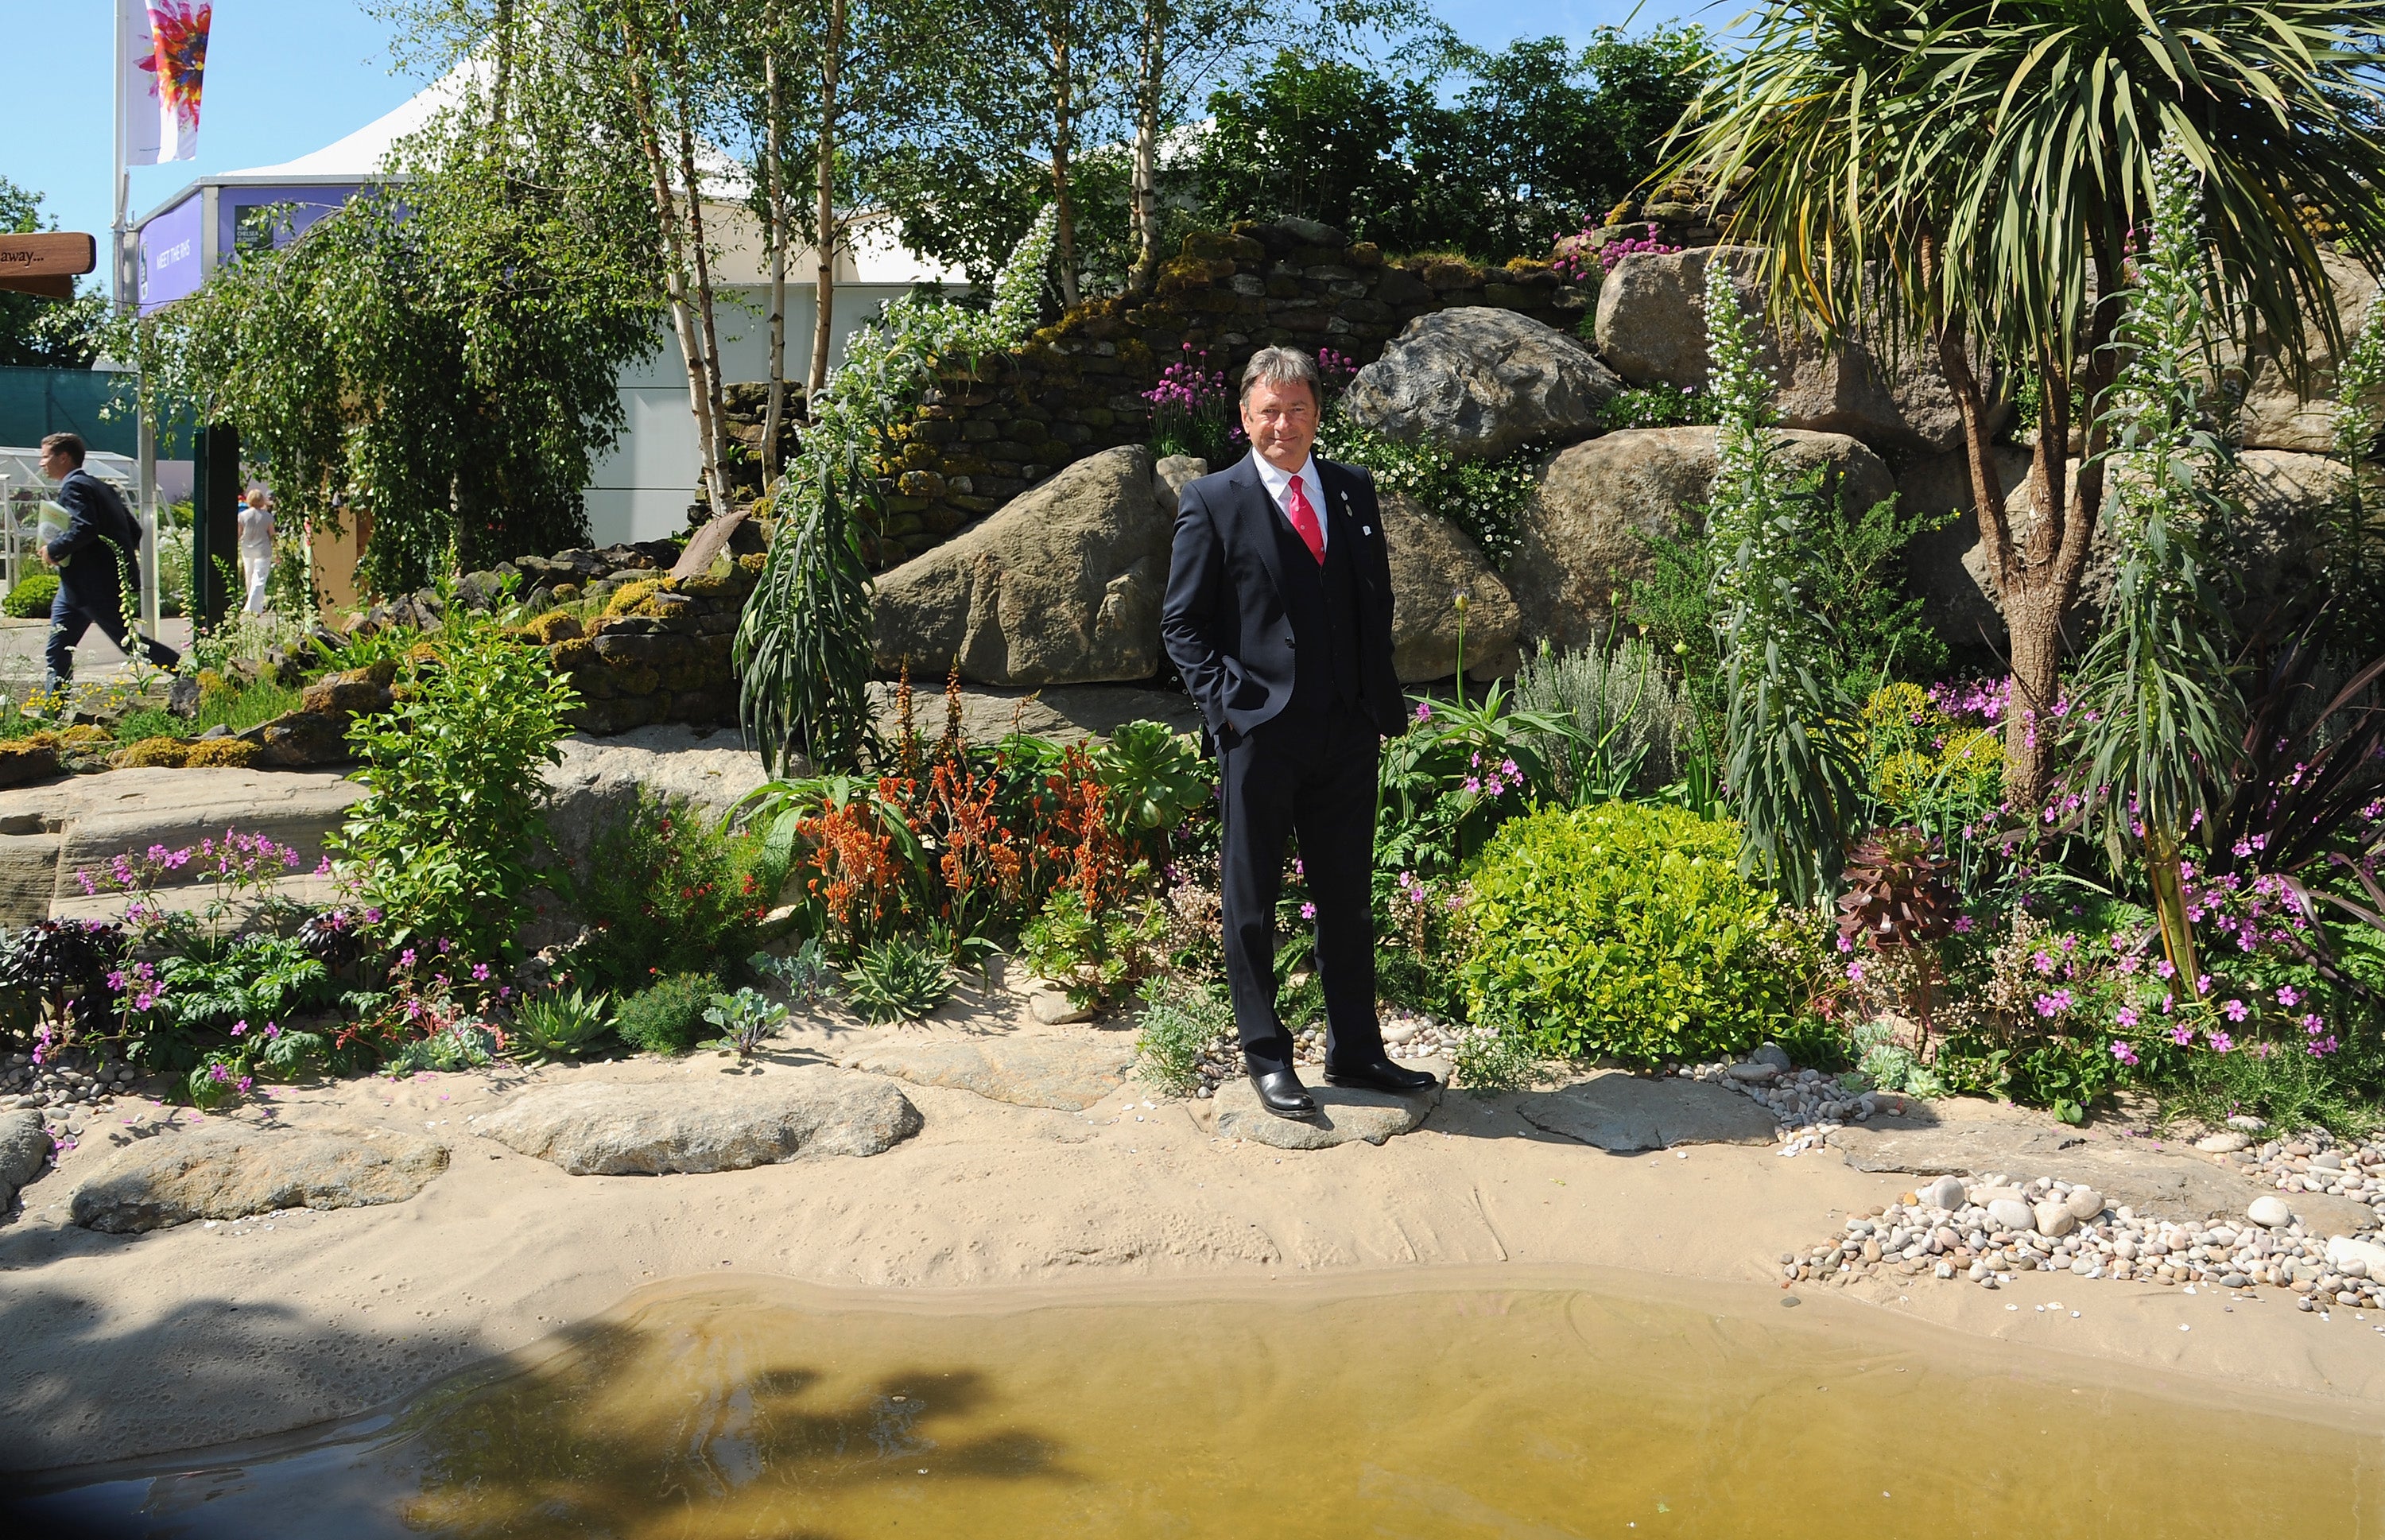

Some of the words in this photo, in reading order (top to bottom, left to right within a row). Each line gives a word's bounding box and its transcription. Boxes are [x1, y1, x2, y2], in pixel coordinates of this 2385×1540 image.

[1, 251, 45, 267] away...
[157, 250, 169, 270] MEET
[170, 245, 180, 263] THE
[180, 239, 190, 258] RHS
